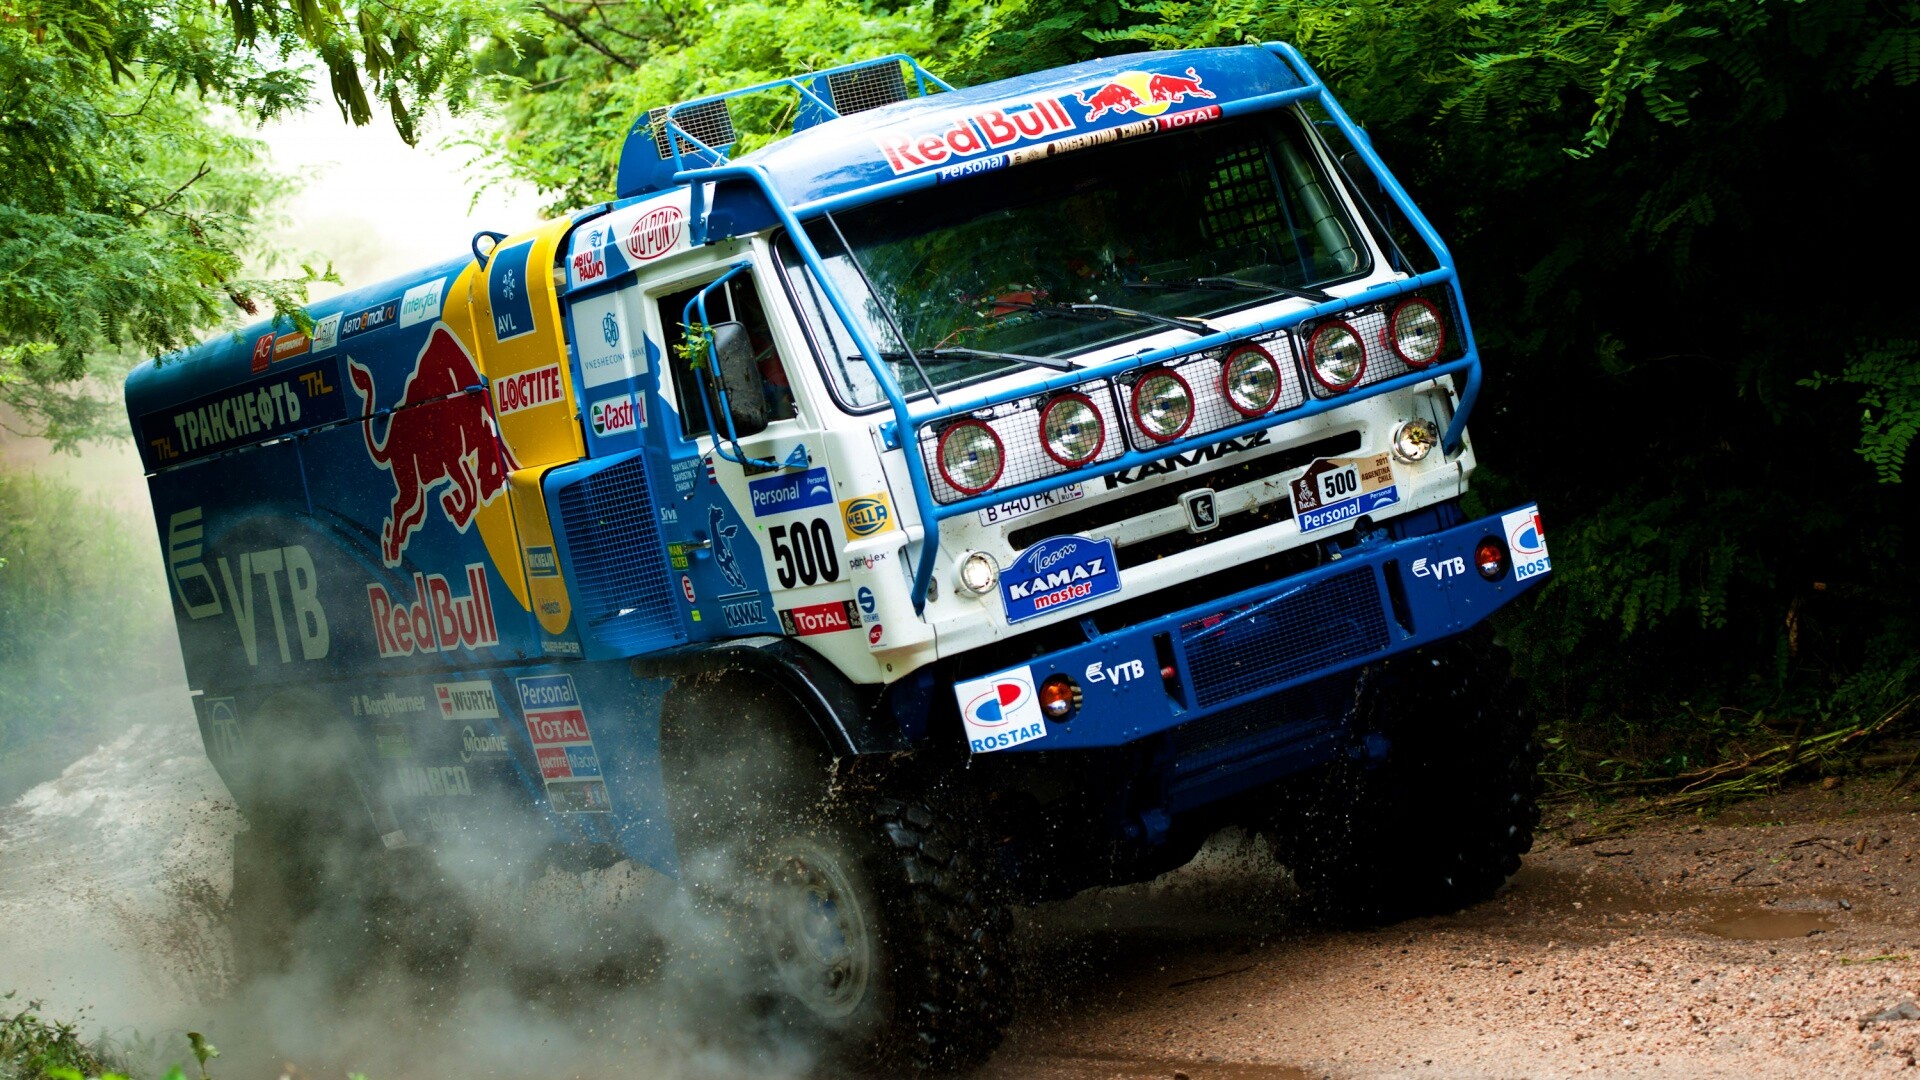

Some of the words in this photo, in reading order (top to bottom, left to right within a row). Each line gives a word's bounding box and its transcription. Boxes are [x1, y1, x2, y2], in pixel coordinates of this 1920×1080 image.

[1163, 107, 1220, 129] TOTAL
[880, 115, 984, 174] Red
[974, 98, 1075, 149] Bull
[1054, 130, 1117, 154] ARGENTINA
[1121, 119, 1152, 139] CHILE
[941, 154, 1004, 179] Personal
[573, 250, 594, 270] АВТО
[579, 260, 604, 282] РАДИО
[402, 283, 439, 319] interfax
[497, 313, 517, 334] AVL
[498, 366, 561, 411] LOCTITE
[173, 381, 301, 452] ТРАНСНЕФТЬ
[1104, 429, 1272, 490] KAMAZ
[806, 474, 827, 486] Personal
[1323, 469, 1357, 498] 500
[1361, 466, 1391, 481] ARGENTINA
[1377, 472, 1393, 484] CHILE
[752, 480, 800, 507] Personal
[1369, 487, 1393, 500] Personal
[847, 505, 888, 526] HELLA
[1304, 497, 1361, 530] Personal
[768, 517, 840, 589] 500
[1028, 542, 1077, 574] Team
[1009, 558, 1106, 601] KAMAZ
[1430, 556, 1466, 580] VTB
[682, 578, 695, 600] E
[1034, 581, 1093, 610] master
[217, 545, 330, 666] VTB
[367, 573, 437, 658] Red
[427, 563, 499, 651] Bull
[722, 600, 767, 628] KAMAZ
[795, 611, 847, 630] TOTAL
[1106, 659, 1145, 685] VTB
[451, 689, 496, 711] WÜRTH
[521, 678, 574, 705] Personal
[528, 716, 587, 740] TOTAL
[971, 722, 1042, 753] ROSTAR
[463, 735, 508, 752] MODINE
[568, 753, 597, 768] Macro
